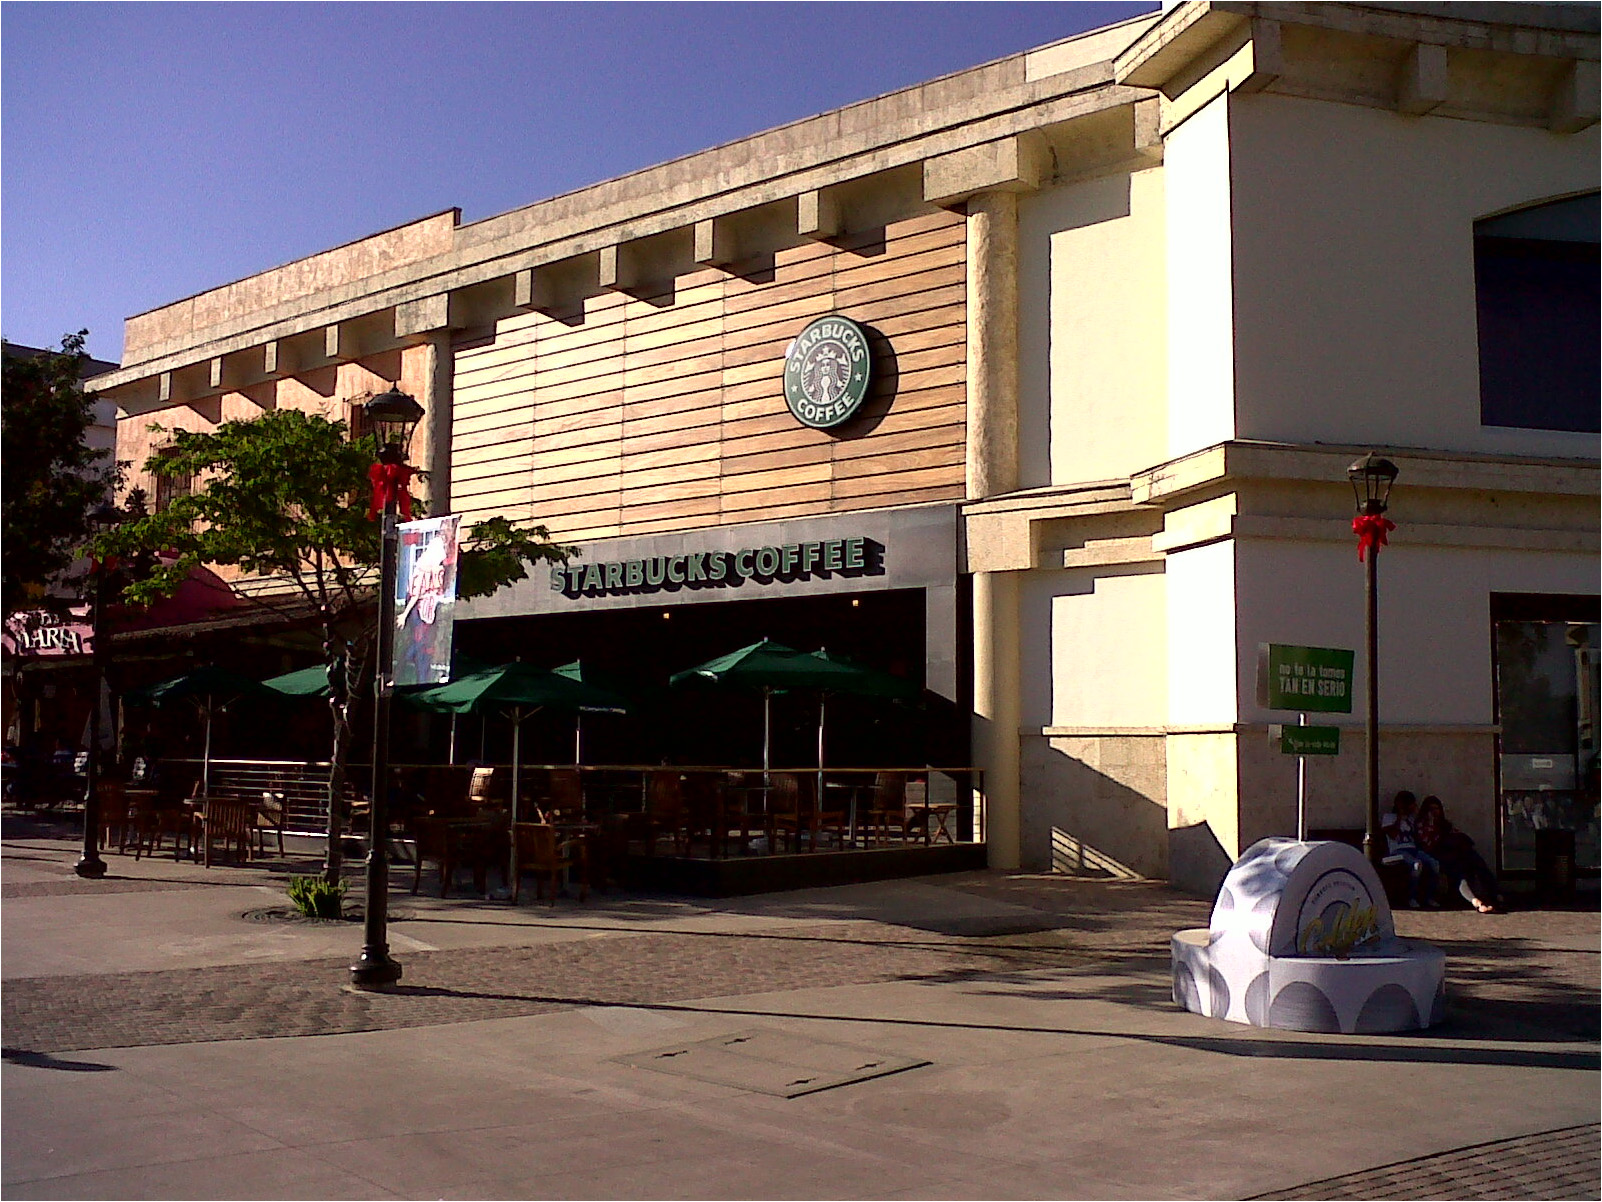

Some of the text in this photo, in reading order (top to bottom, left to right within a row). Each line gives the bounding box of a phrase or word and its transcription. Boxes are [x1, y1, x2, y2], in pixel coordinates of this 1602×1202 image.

[790, 324, 865, 373] STARBUCKS
[796, 391, 855, 422] COFFEE
[551, 537, 866, 592] STARBUCKS COFFEE
[1279, 676, 1346, 697] TAN EN SERIO
